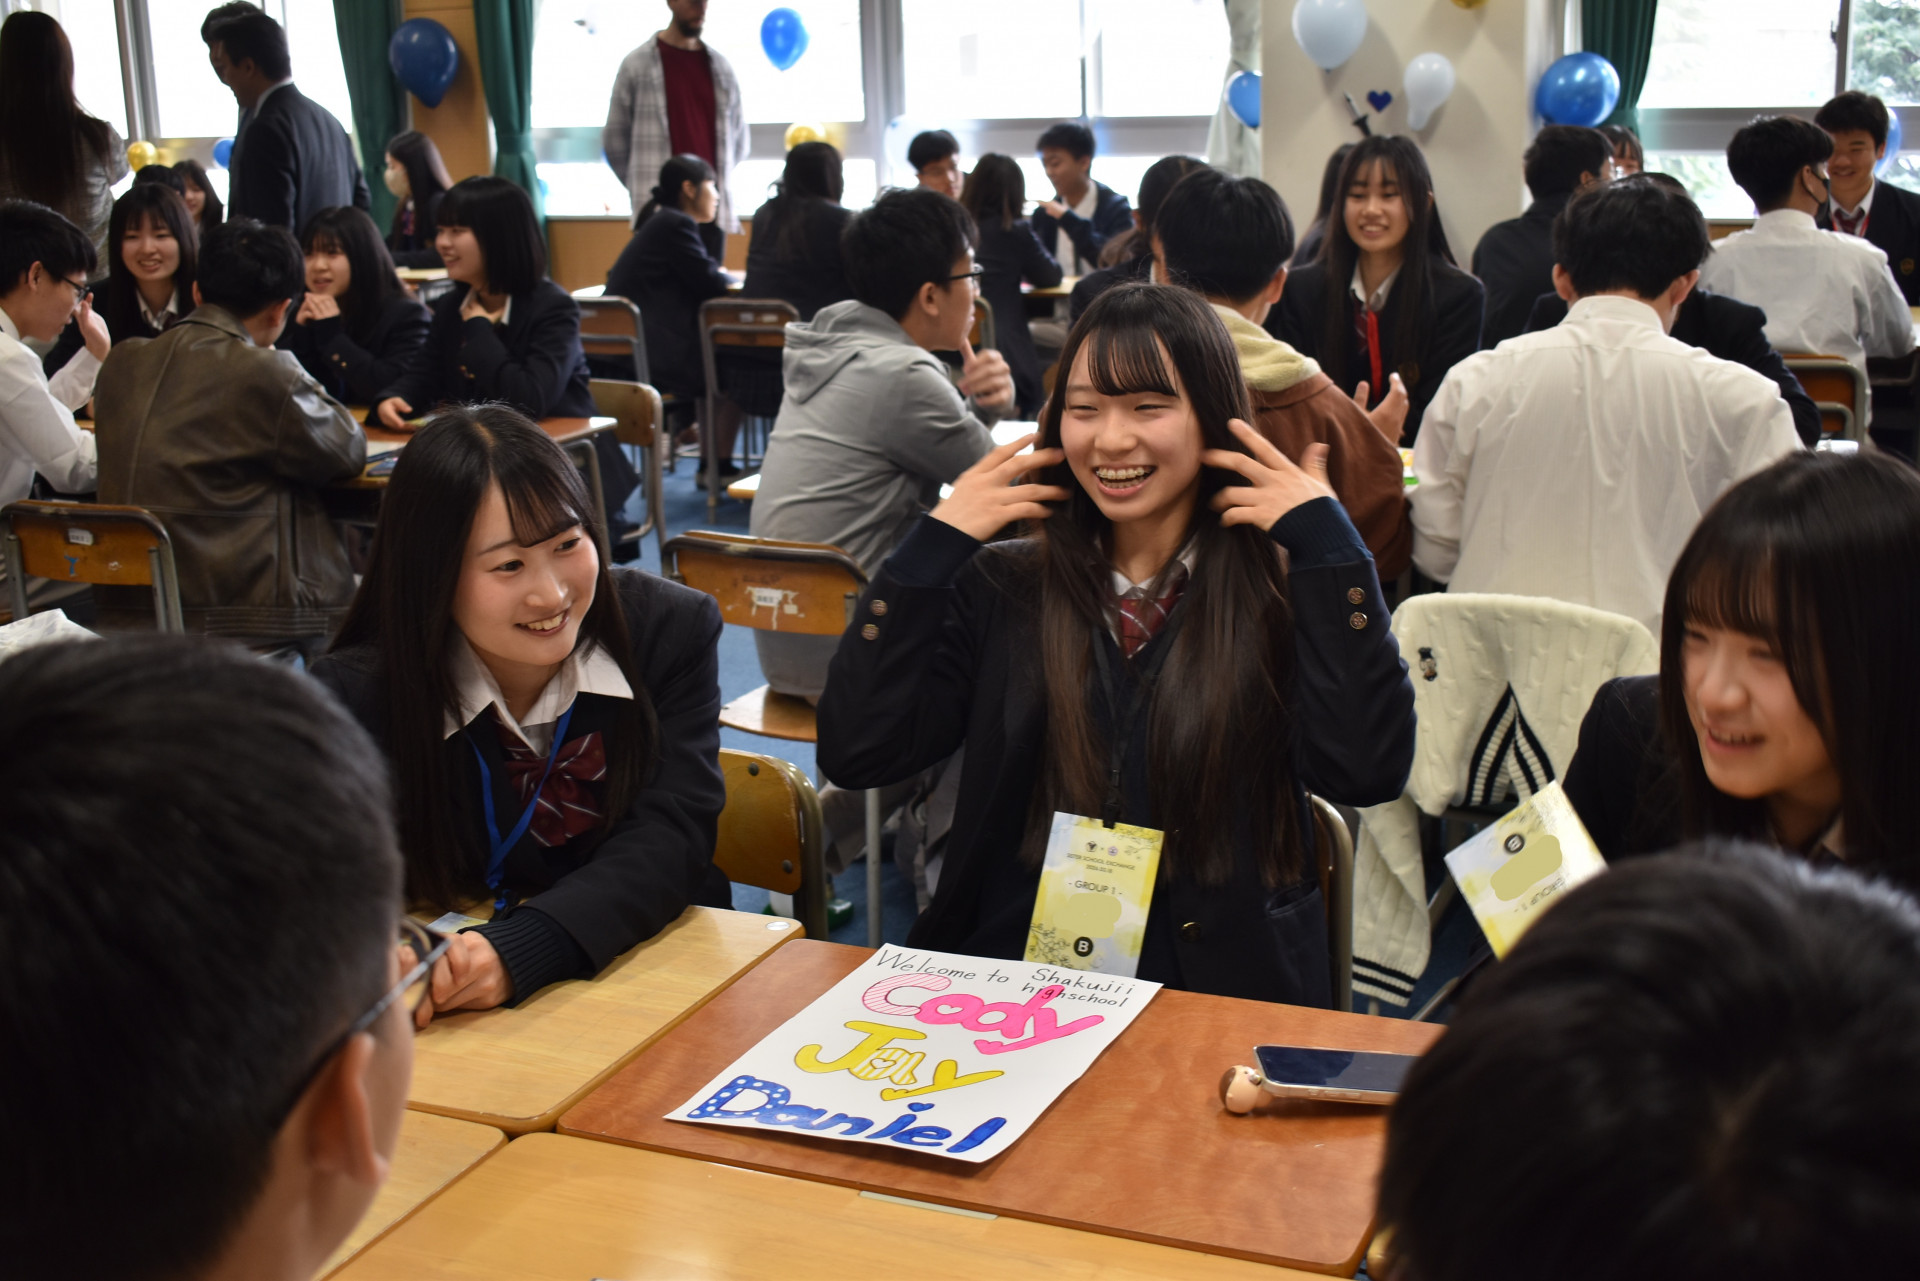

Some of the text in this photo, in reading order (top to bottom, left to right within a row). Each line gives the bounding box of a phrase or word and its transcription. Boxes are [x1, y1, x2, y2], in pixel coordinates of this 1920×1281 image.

[1082, 855, 1105, 865] SCHOOL
[1074, 880, 1109, 893] GROUP
[1077, 940, 1090, 952] B
[876, 949, 1136, 995] Welcome to Shakujii
[862, 972, 1105, 1055] Cody
[794, 1020, 1005, 1101] Jay
[686, 1075, 1008, 1154] Daniel
